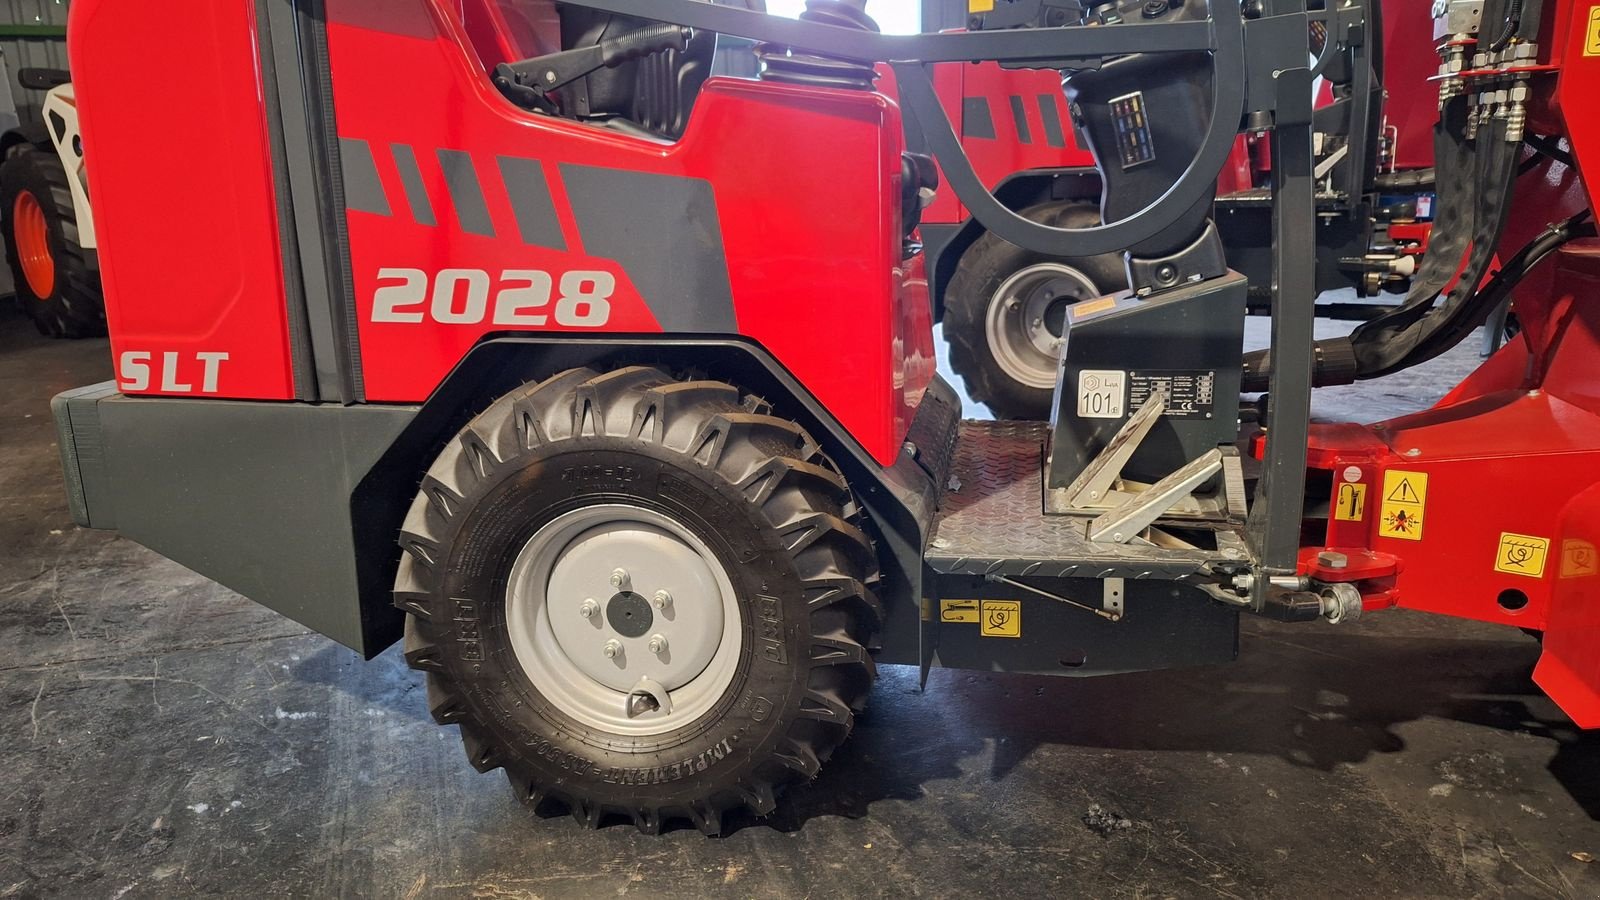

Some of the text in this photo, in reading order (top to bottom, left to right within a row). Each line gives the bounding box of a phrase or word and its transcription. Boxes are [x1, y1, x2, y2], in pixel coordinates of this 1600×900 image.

[371, 267, 615, 327] 2028
[120, 351, 230, 392] SLT
[1083, 392, 1111, 414] 101
[603, 738, 733, 787] IMPLEMENT
